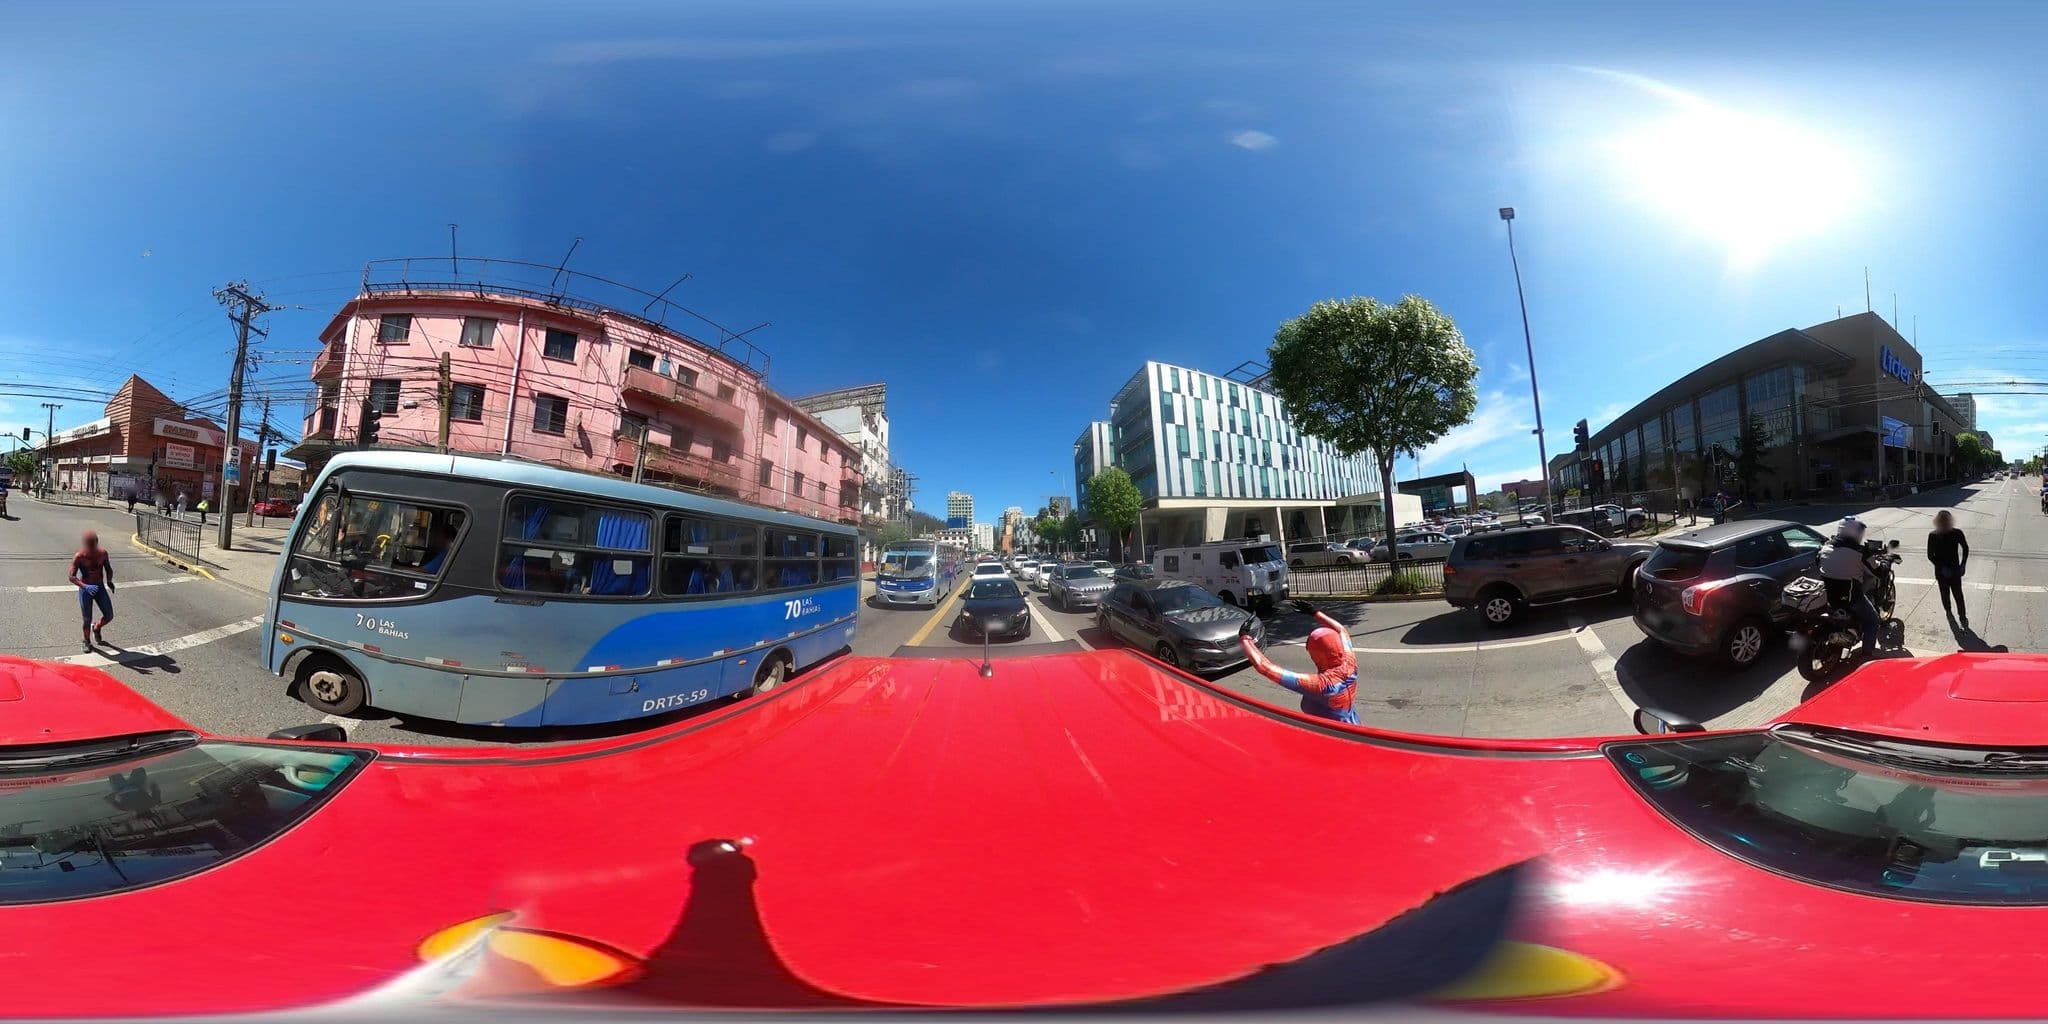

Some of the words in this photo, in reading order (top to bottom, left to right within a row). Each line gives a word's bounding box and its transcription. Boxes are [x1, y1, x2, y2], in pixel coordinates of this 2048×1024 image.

[785, 599, 801, 620] 70
[802, 597, 813, 607] LAS
[356, 613, 376, 630] 70
[379, 619, 395, 629] LAS
[378, 626, 409, 640] BAHIAS
[642, 688, 708, 712] DRTS-59
